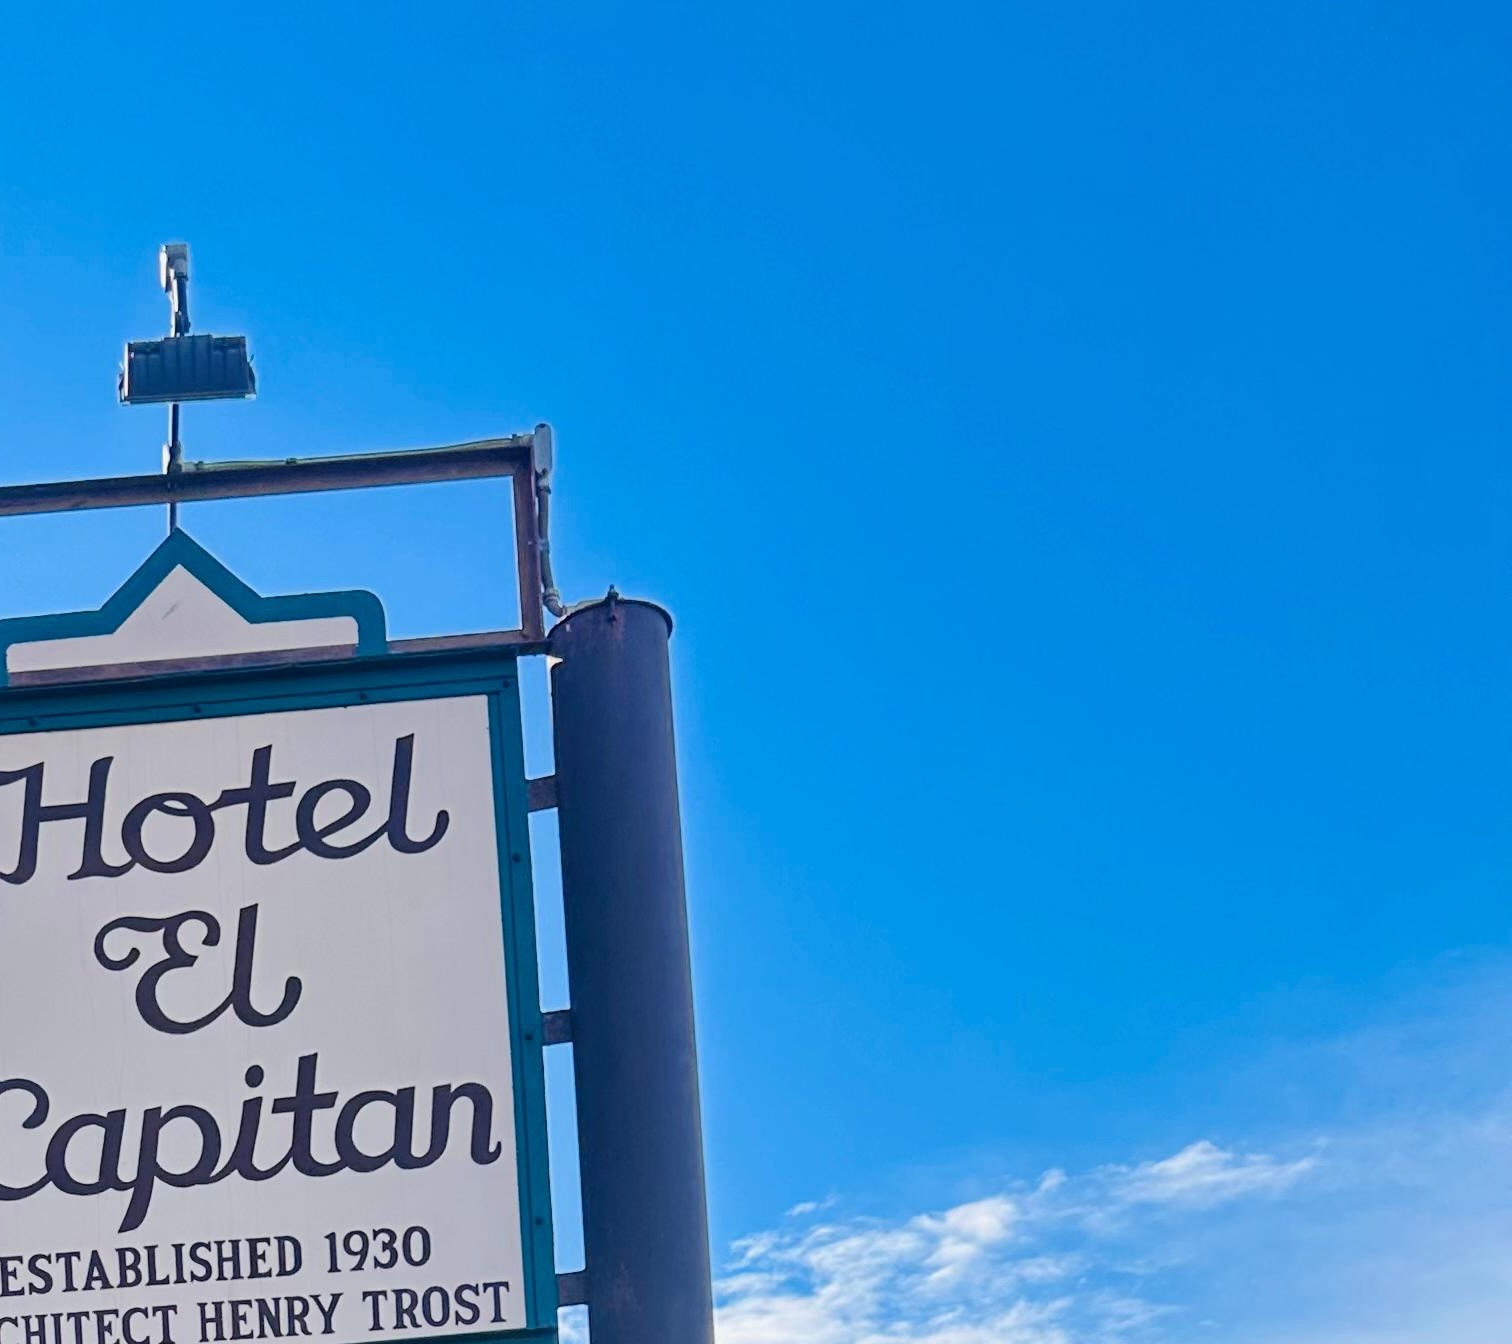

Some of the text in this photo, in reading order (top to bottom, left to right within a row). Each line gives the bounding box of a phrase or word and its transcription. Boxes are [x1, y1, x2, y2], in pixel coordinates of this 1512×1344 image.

[93, 902, 303, 1035] El
[323, 1225, 432, 1275] 1930
[195, 1292, 345, 1343] HENRY
[361, 1281, 511, 1332] TROST
